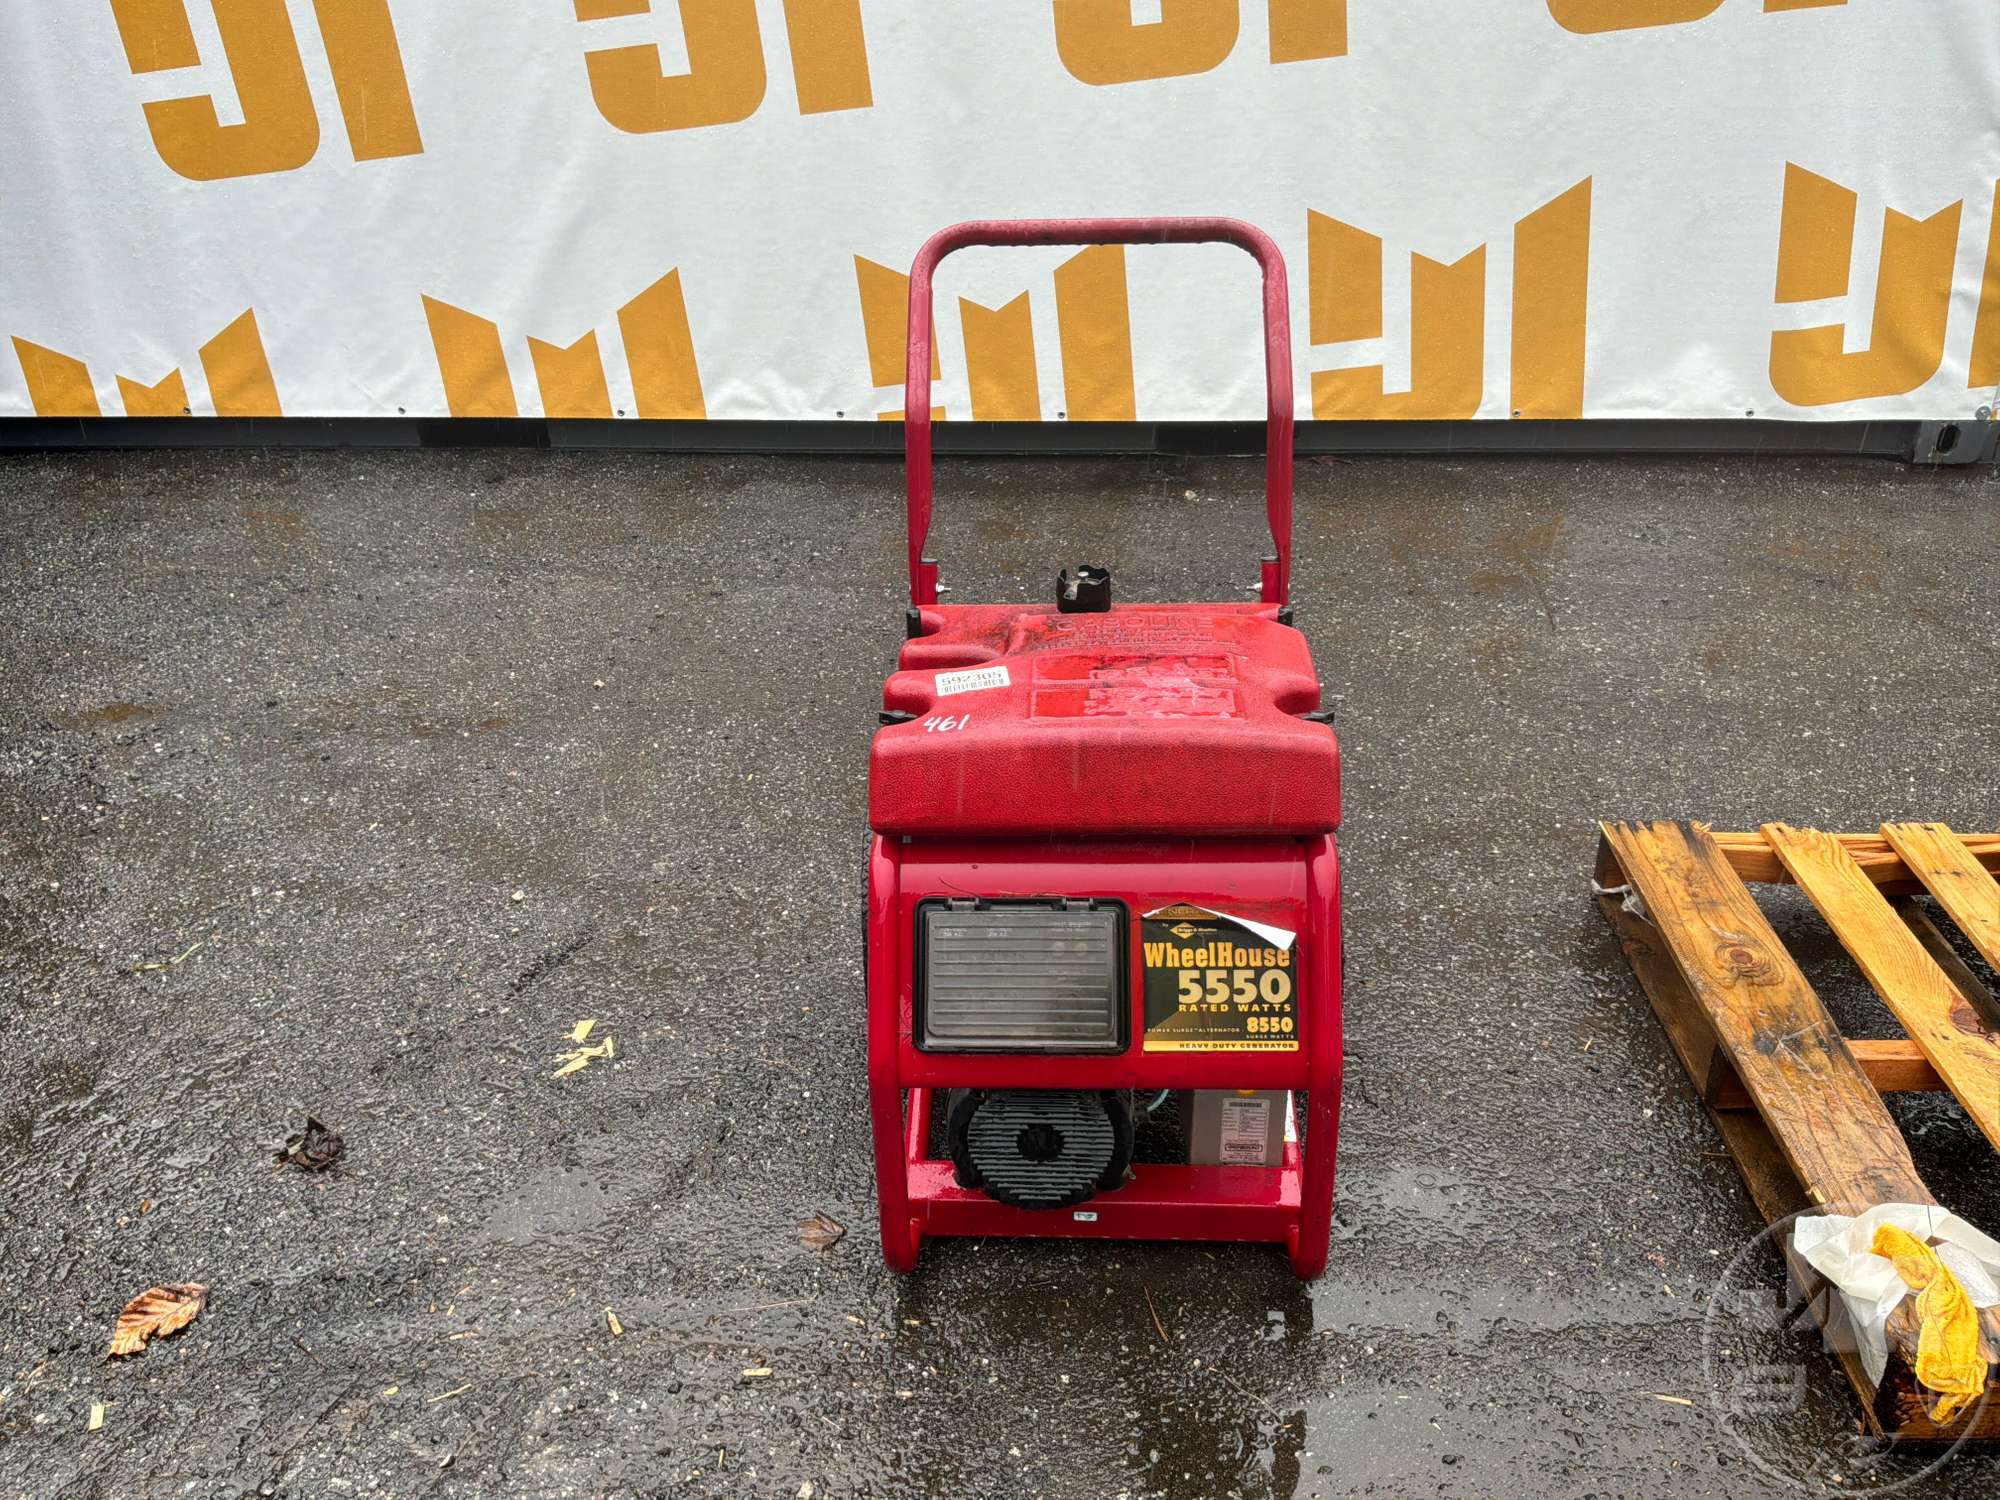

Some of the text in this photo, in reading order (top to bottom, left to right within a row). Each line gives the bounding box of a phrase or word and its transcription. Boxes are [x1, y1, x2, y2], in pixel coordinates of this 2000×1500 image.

[941, 671, 1002, 686] 592305
[923, 713, 970, 733] 461
[1144, 942, 1291, 968] WheelHouse
[1178, 969, 1291, 1004] 5550
[1178, 1004, 1292, 1012] RATED WATTS
[1246, 1016, 1294, 1033] 8550
